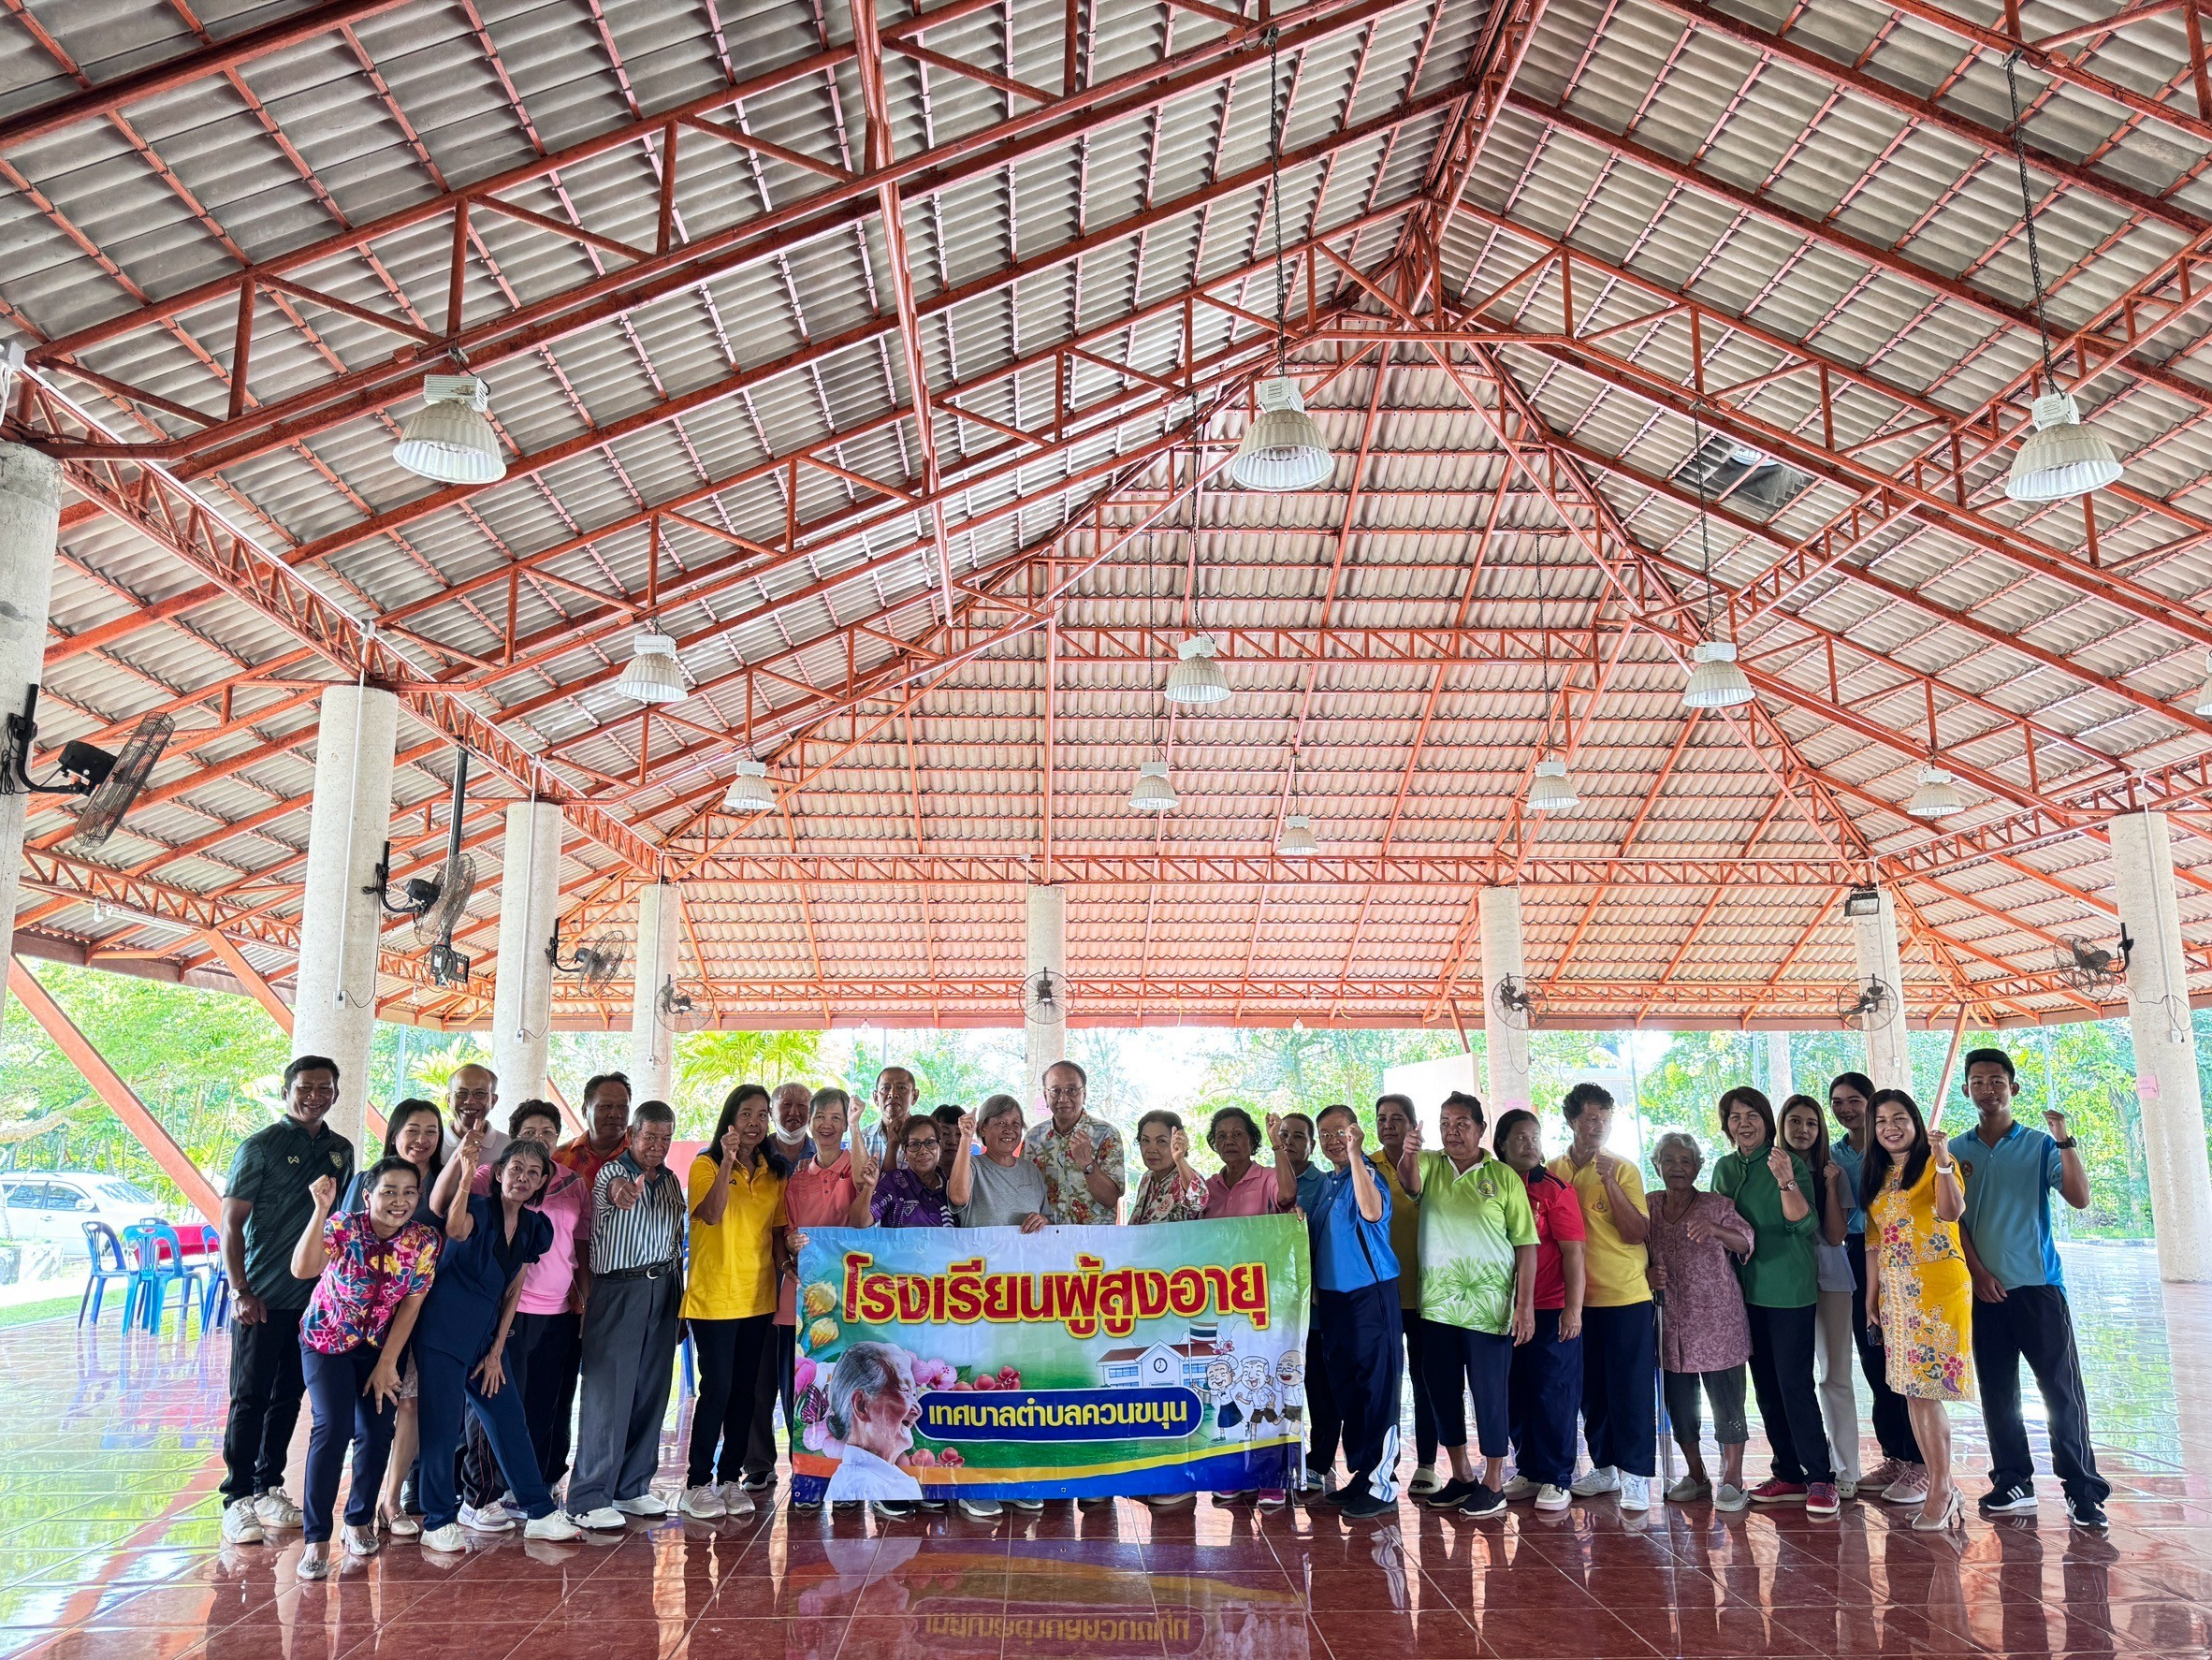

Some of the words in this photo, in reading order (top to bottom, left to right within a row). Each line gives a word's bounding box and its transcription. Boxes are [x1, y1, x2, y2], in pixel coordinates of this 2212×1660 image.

[843, 1252, 1270, 1338] โรงเรียนผู้สูงอายุ
[929, 1398, 1187, 1430] เทศบาลตำบลควนขนุน
